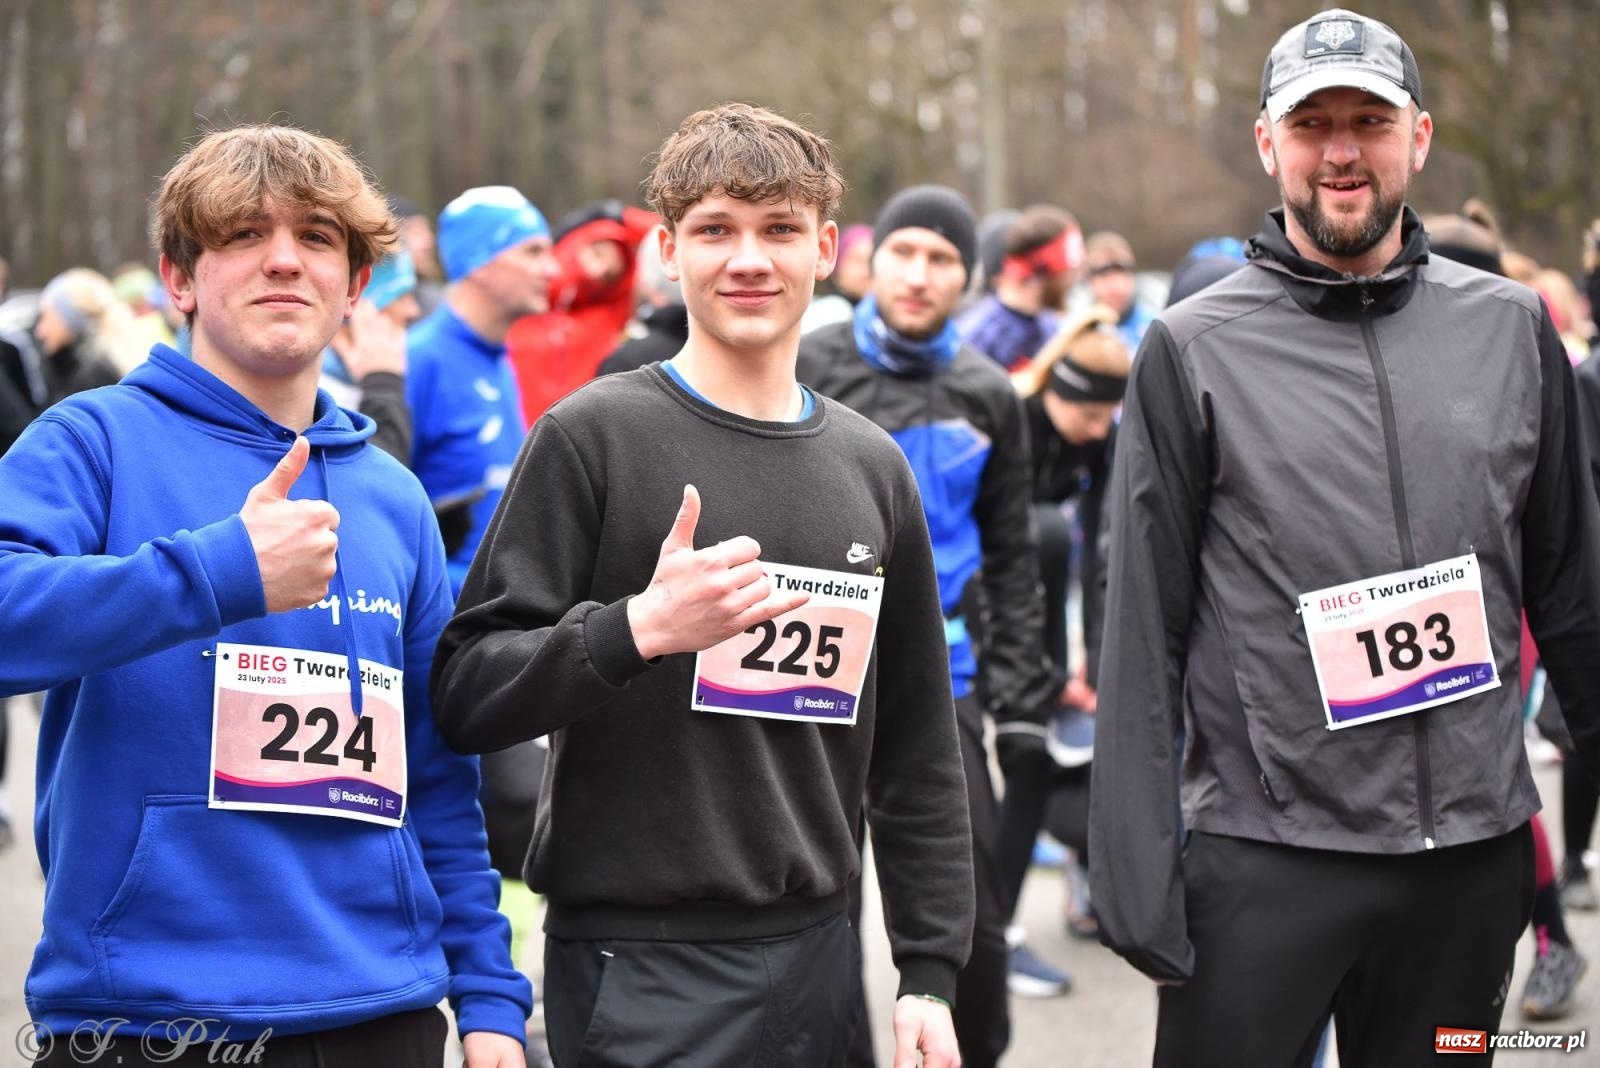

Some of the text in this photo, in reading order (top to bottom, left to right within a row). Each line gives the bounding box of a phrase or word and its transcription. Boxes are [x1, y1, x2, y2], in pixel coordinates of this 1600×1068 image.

[775, 573, 869, 600] Twardziela
[1319, 567, 1465, 612] BIEG Twardziela
[740, 619, 844, 679] 225
[1356, 612, 1456, 678] 183
[238, 653, 288, 672] BIEG
[248, 675, 266, 685] luty
[267, 676, 287, 684] 2025
[1436, 675, 1471, 692] Racibórz
[804, 698, 835, 710] Racibórz
[260, 702, 377, 773] 224
[342, 791, 379, 806] Racibórz
